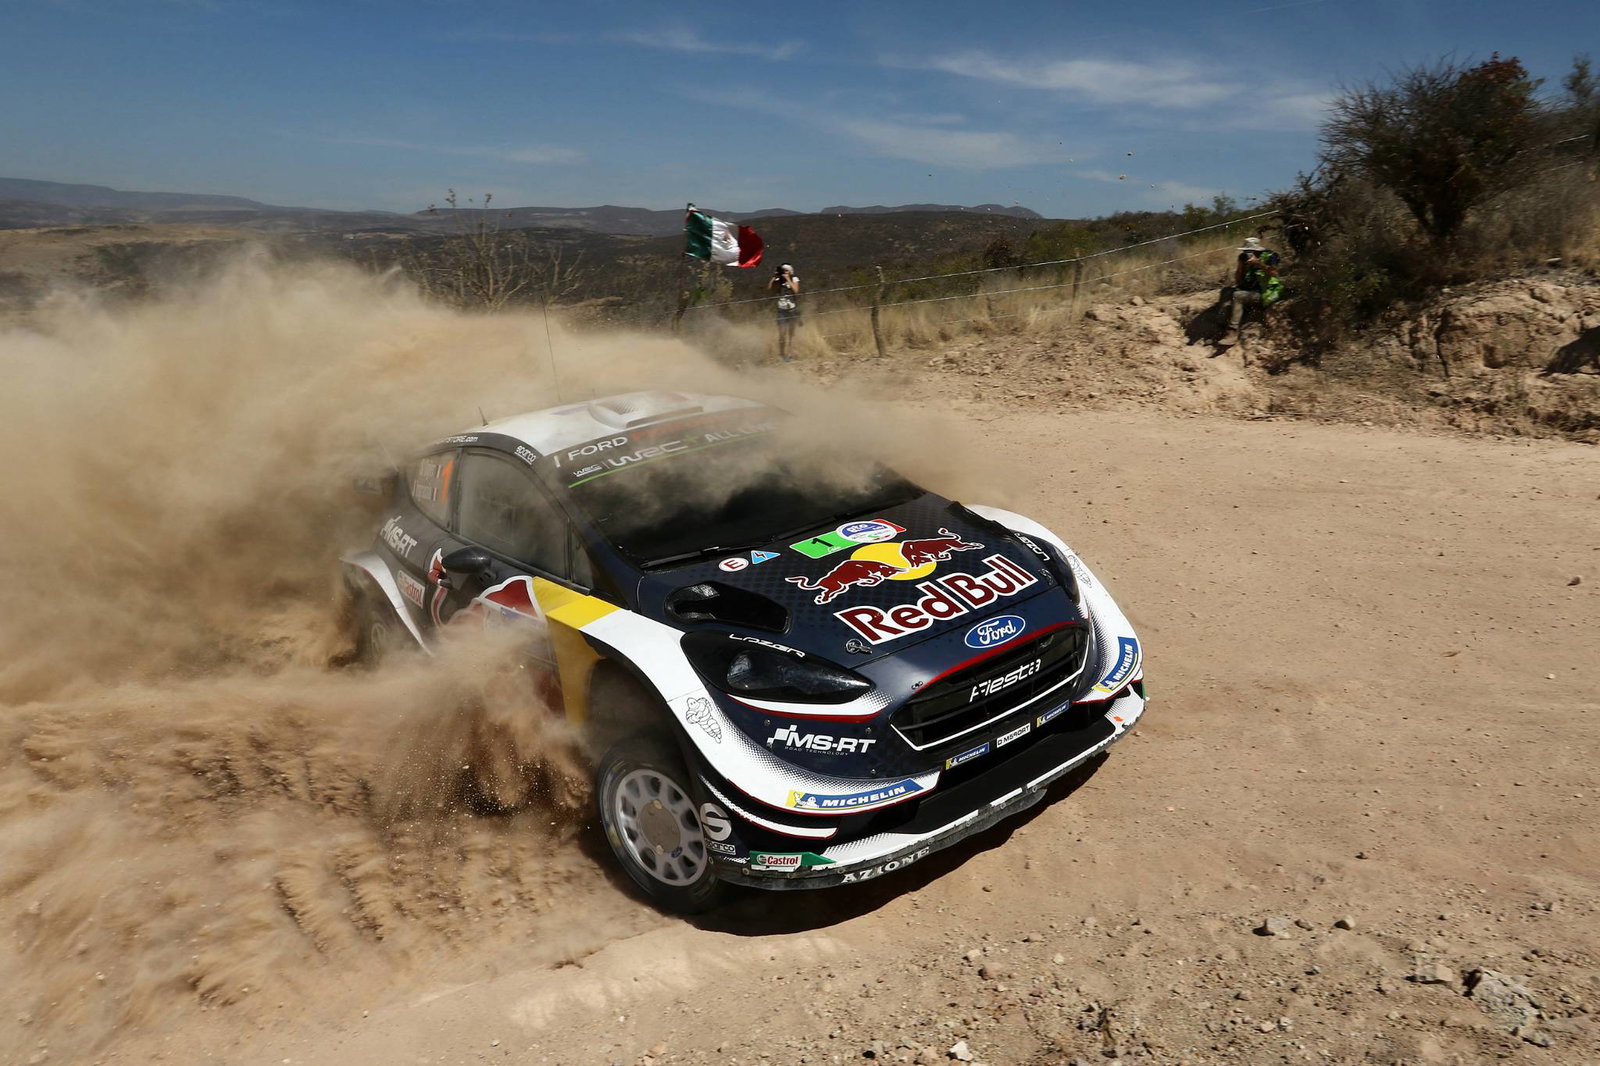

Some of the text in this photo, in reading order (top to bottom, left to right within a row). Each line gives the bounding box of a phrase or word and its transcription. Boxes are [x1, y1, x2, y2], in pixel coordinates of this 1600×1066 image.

[704, 429, 740, 443] ALL
[567, 436, 629, 462] FORD
[811, 538, 834, 547] 1
[724, 560, 744, 569] E
[837, 555, 1037, 643] Red Bull
[977, 620, 1017, 645] Ford
[729, 633, 806, 658] LAZER
[1112, 643, 1133, 681] MICHELIN
[821, 786, 906, 807] MICHELIN
[767, 856, 799, 865] Castrol
[841, 846, 930, 884] AZIONE
